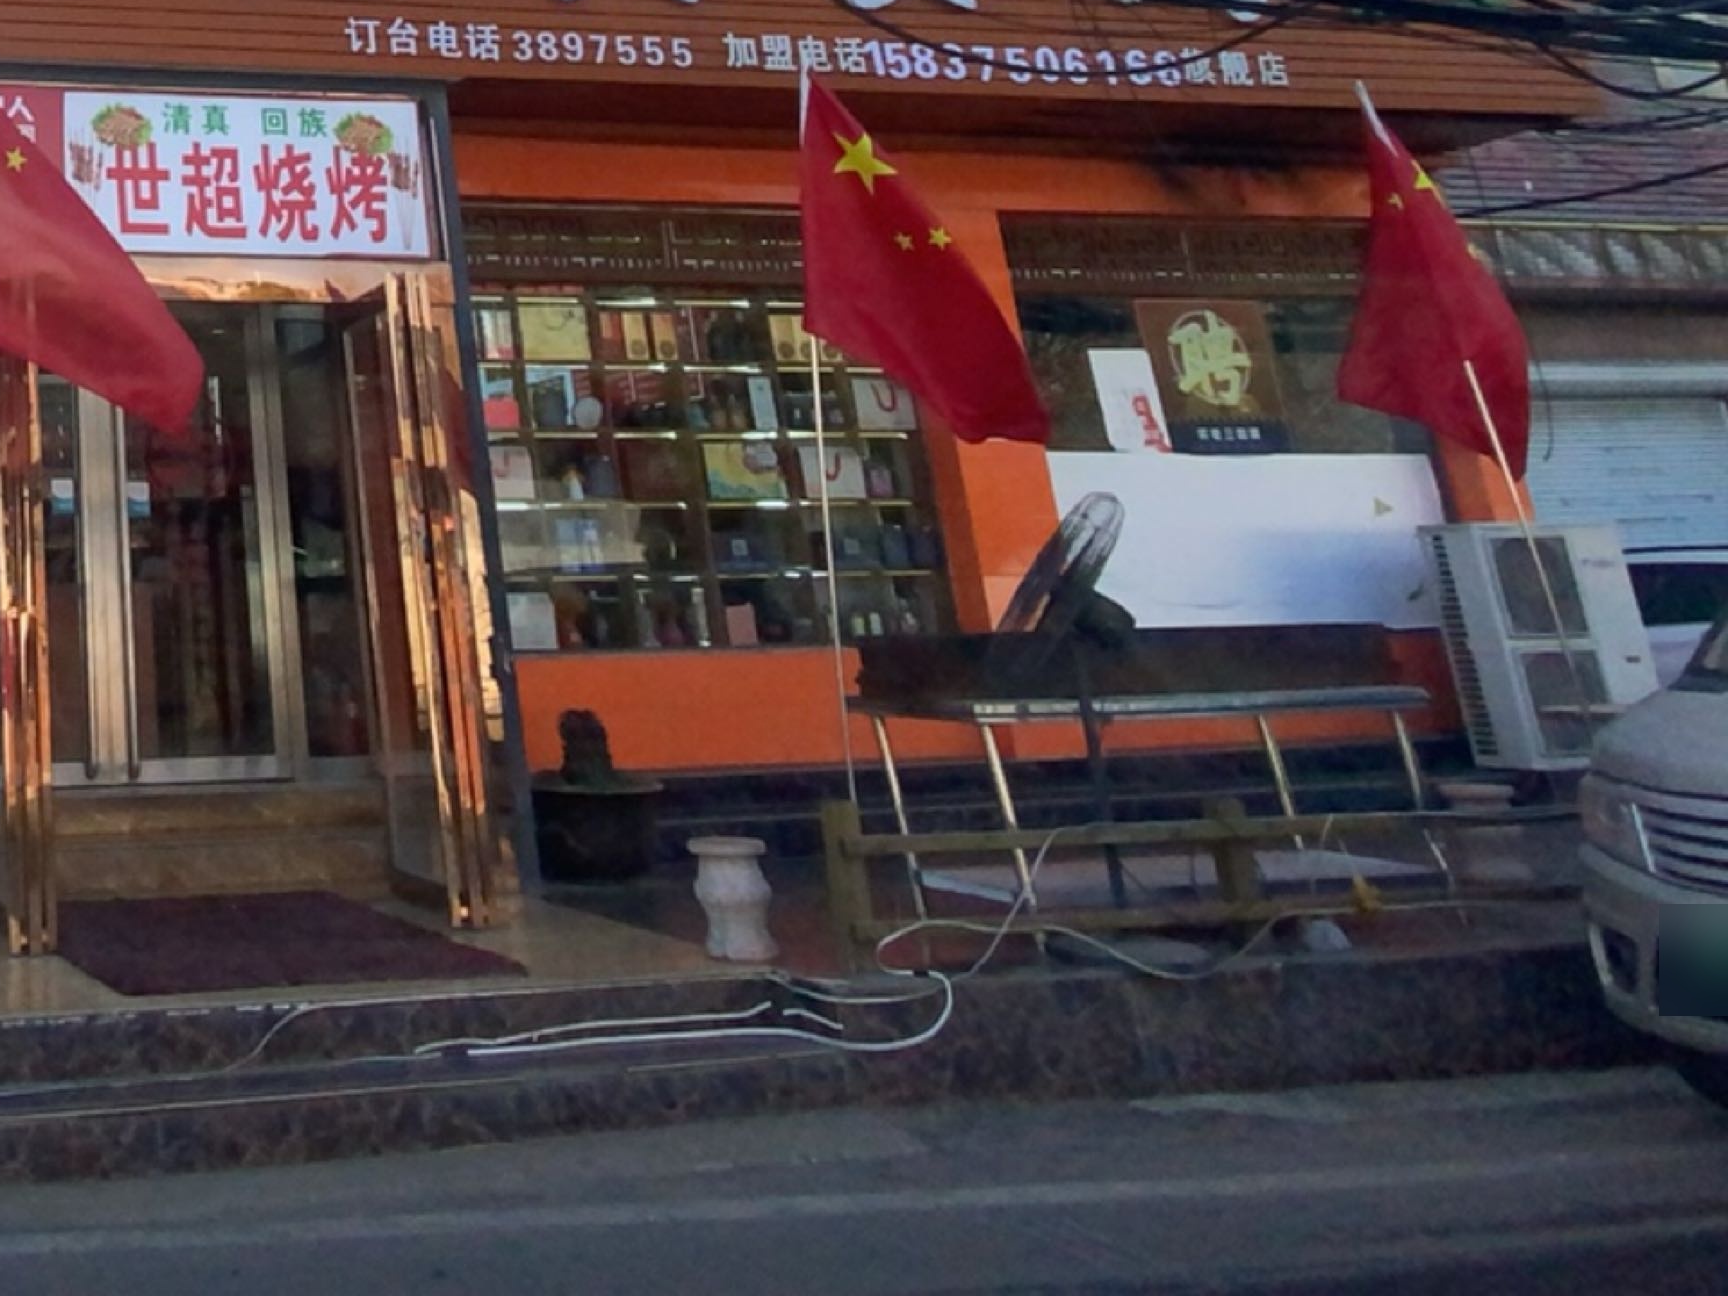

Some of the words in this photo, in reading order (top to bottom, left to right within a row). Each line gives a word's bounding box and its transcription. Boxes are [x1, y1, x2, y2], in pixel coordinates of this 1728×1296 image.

[161, 101, 231, 135] 清真
[260, 106, 330, 138] 回族
[106, 141, 390, 244] 世超烧烤
